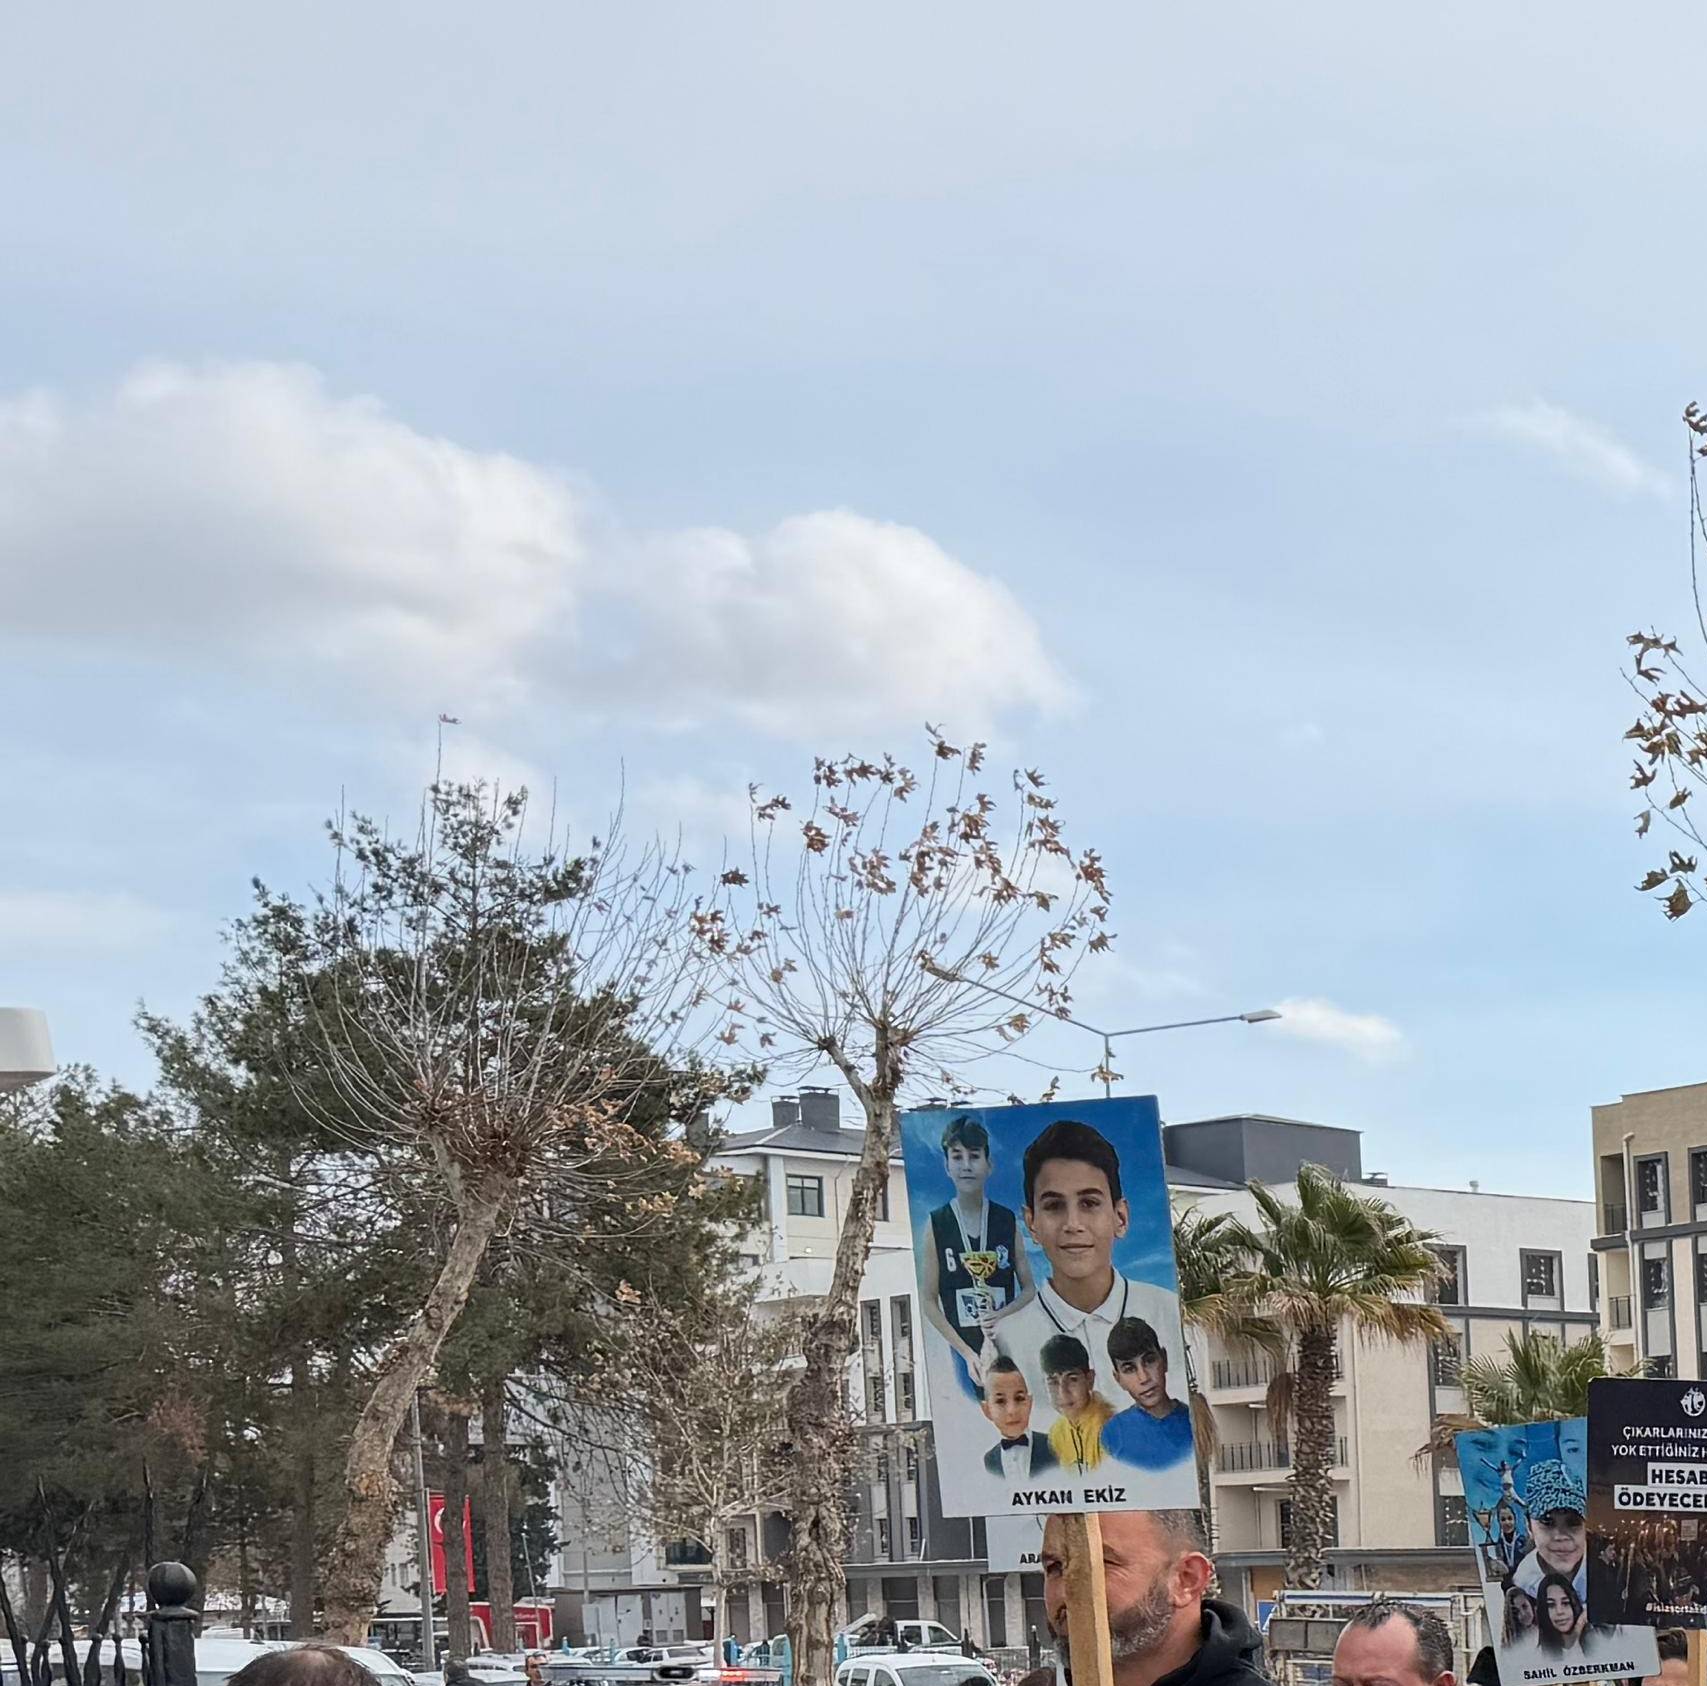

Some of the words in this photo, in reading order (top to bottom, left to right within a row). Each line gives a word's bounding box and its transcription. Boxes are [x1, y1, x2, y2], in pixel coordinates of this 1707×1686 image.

[1611, 1444, 1637, 1458] YOK
[1639, 1442, 1699, 1459] ETTİĞİNİZ
[1012, 1488, 1073, 1507] AYKAN
[1084, 1485, 1126, 1504] EKİZ
[1523, 1667, 1557, 1680] SAHİL
